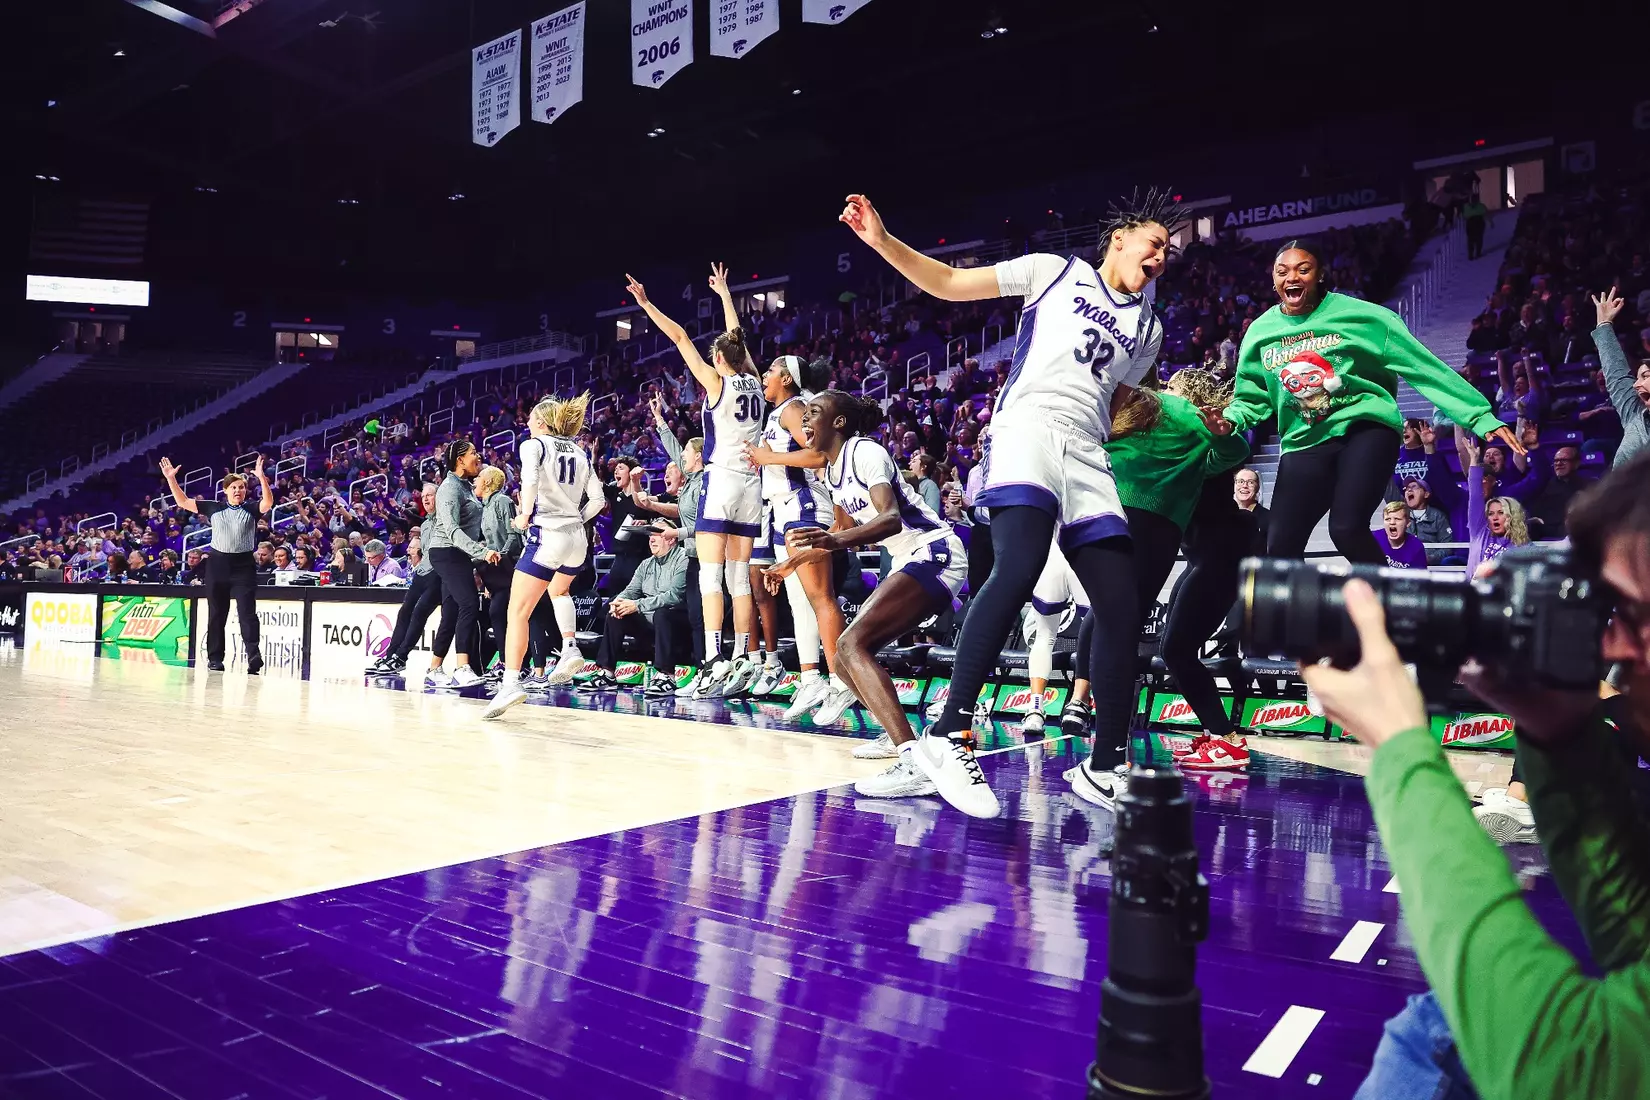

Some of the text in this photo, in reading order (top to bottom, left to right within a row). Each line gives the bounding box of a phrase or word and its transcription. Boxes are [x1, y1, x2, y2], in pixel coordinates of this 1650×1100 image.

[648, 0, 672, 16] WNIT
[719, 1, 738, 14] 1977
[745, 2, 764, 14] 1984
[536, 7, 581, 36] K-STATE
[632, 5, 688, 36] CHAMPIONS
[718, 12, 737, 25] 1978
[745, 13, 764, 26] 1987
[718, 23, 737, 35] 1979
[477, 35, 518, 62] K-STATE
[545, 37, 568, 53] WNIT
[637, 36, 681, 67] 2006
[556, 55, 572, 67] 2015
[486, 63, 506, 80] AIAW
[537, 72, 552, 84] 2006
[556, 64, 571, 76] 2018
[497, 81, 511, 92] 1977
[536, 82, 551, 93] 2007
[555, 74, 570, 86] 2023
[479, 89, 491, 99] 1972
[536, 91, 550, 103] 2013
[478, 98, 491, 108] 1973
[478, 107, 491, 117] 1974
[477, 116, 490, 127] 1975
[836, 252, 852, 273] 5
[233, 310, 248, 327] 2
[382, 318, 396, 335] 3
[1073, 327, 1115, 381] 32
[1263, 333, 1343, 371] Christmas
[734, 394, 761, 422] 30
[553, 441, 575, 454] SIDES
[558, 455, 577, 486] 11
[1395, 460, 1429, 471] K-STAT
[31, 600, 94, 629] QDOBA
[322, 624, 363, 647] TACO
[260, 635, 301, 658] hristi
[1250, 704, 1311, 727] LIBMAN
[1441, 718, 1514, 745] LIBMAN
